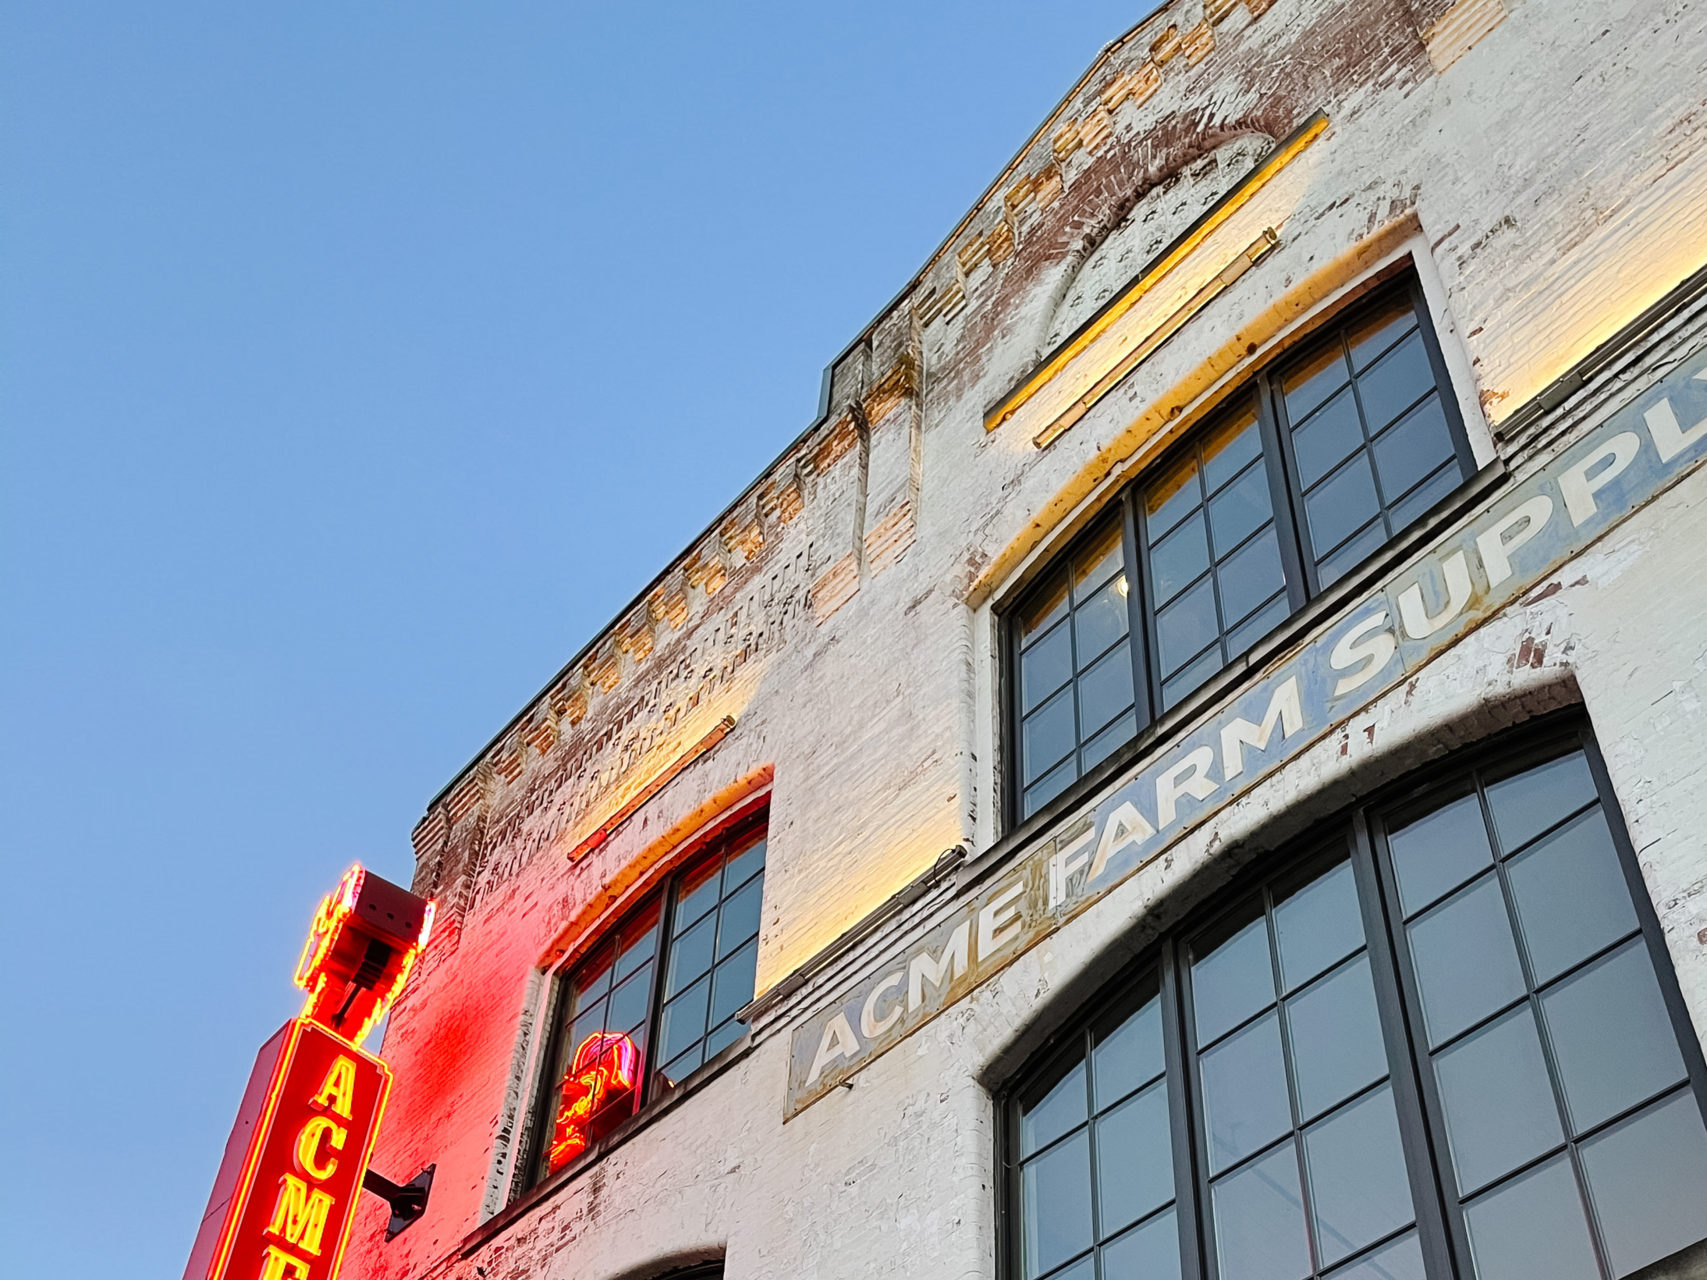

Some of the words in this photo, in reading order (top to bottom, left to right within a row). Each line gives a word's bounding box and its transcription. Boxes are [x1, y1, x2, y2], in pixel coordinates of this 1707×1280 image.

[804, 880, 1026, 1087] ACME
[1048, 674, 1304, 910] FARM
[1329, 366, 1707, 697] SUPPL
